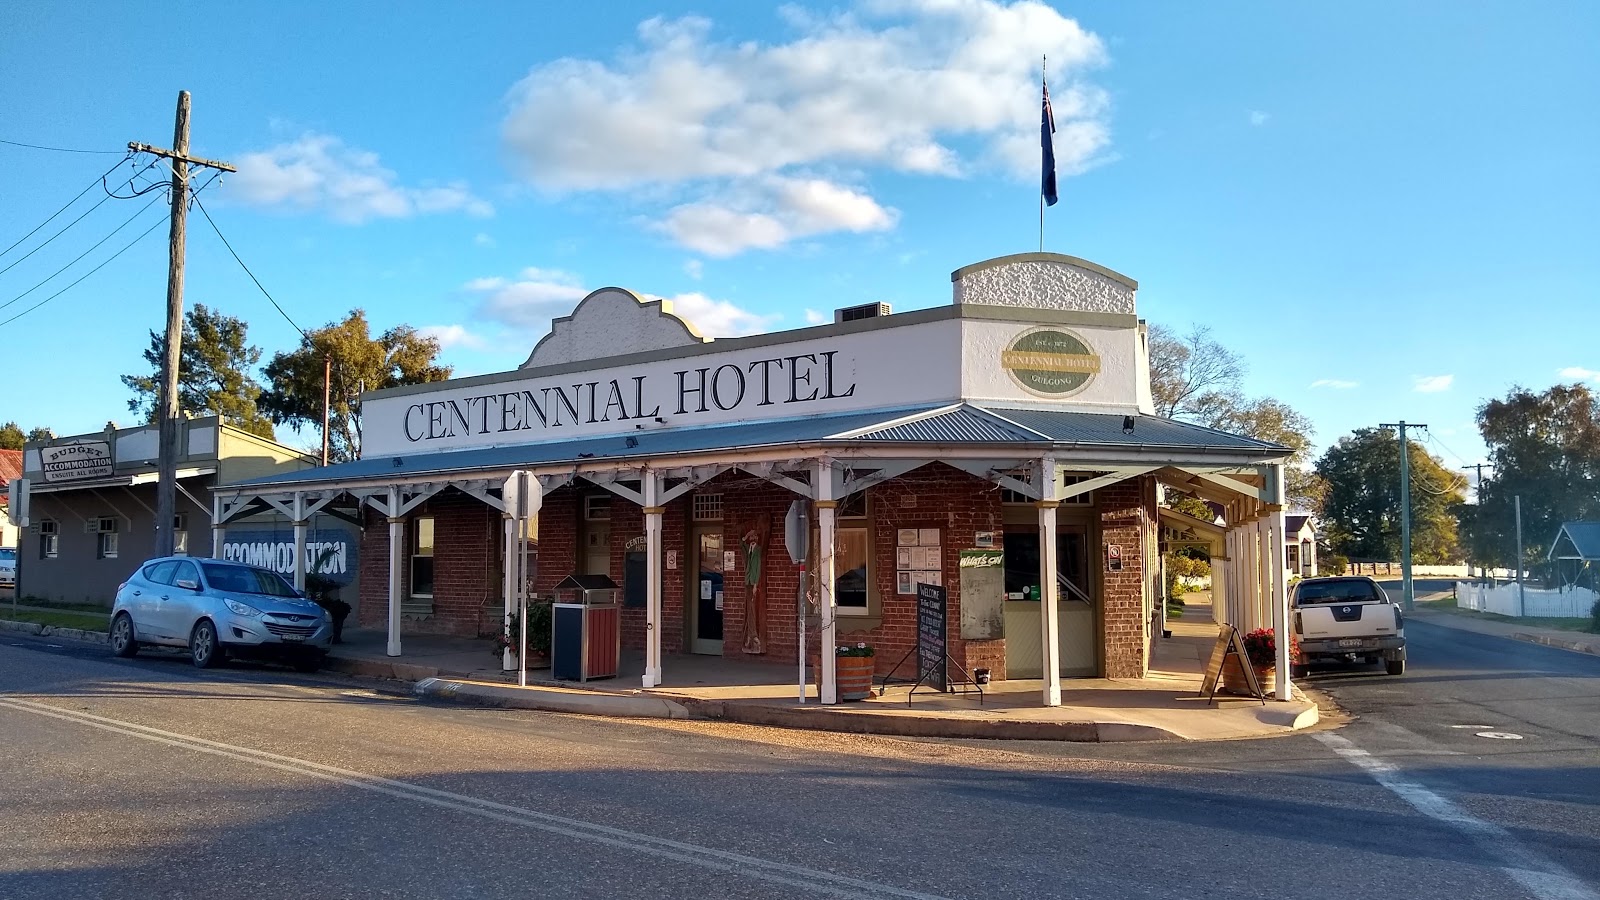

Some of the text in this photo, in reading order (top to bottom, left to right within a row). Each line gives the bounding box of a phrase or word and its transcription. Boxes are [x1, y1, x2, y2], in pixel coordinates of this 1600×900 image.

[1005, 355, 1096, 368] CENTENNIAL HOTEL
[1031, 375, 1072, 386] GULGONG
[403, 350, 857, 443] CENTENNIAL HOTEL
[50, 447, 103, 460] BUDGET
[44, 458, 112, 472] ACCOMMODATION
[52, 471, 74, 479] ENSUITE
[88, 468, 108, 476] ROOMS
[223, 541, 347, 575] CCOMMODTION
[988, 554, 1003, 566] ON
